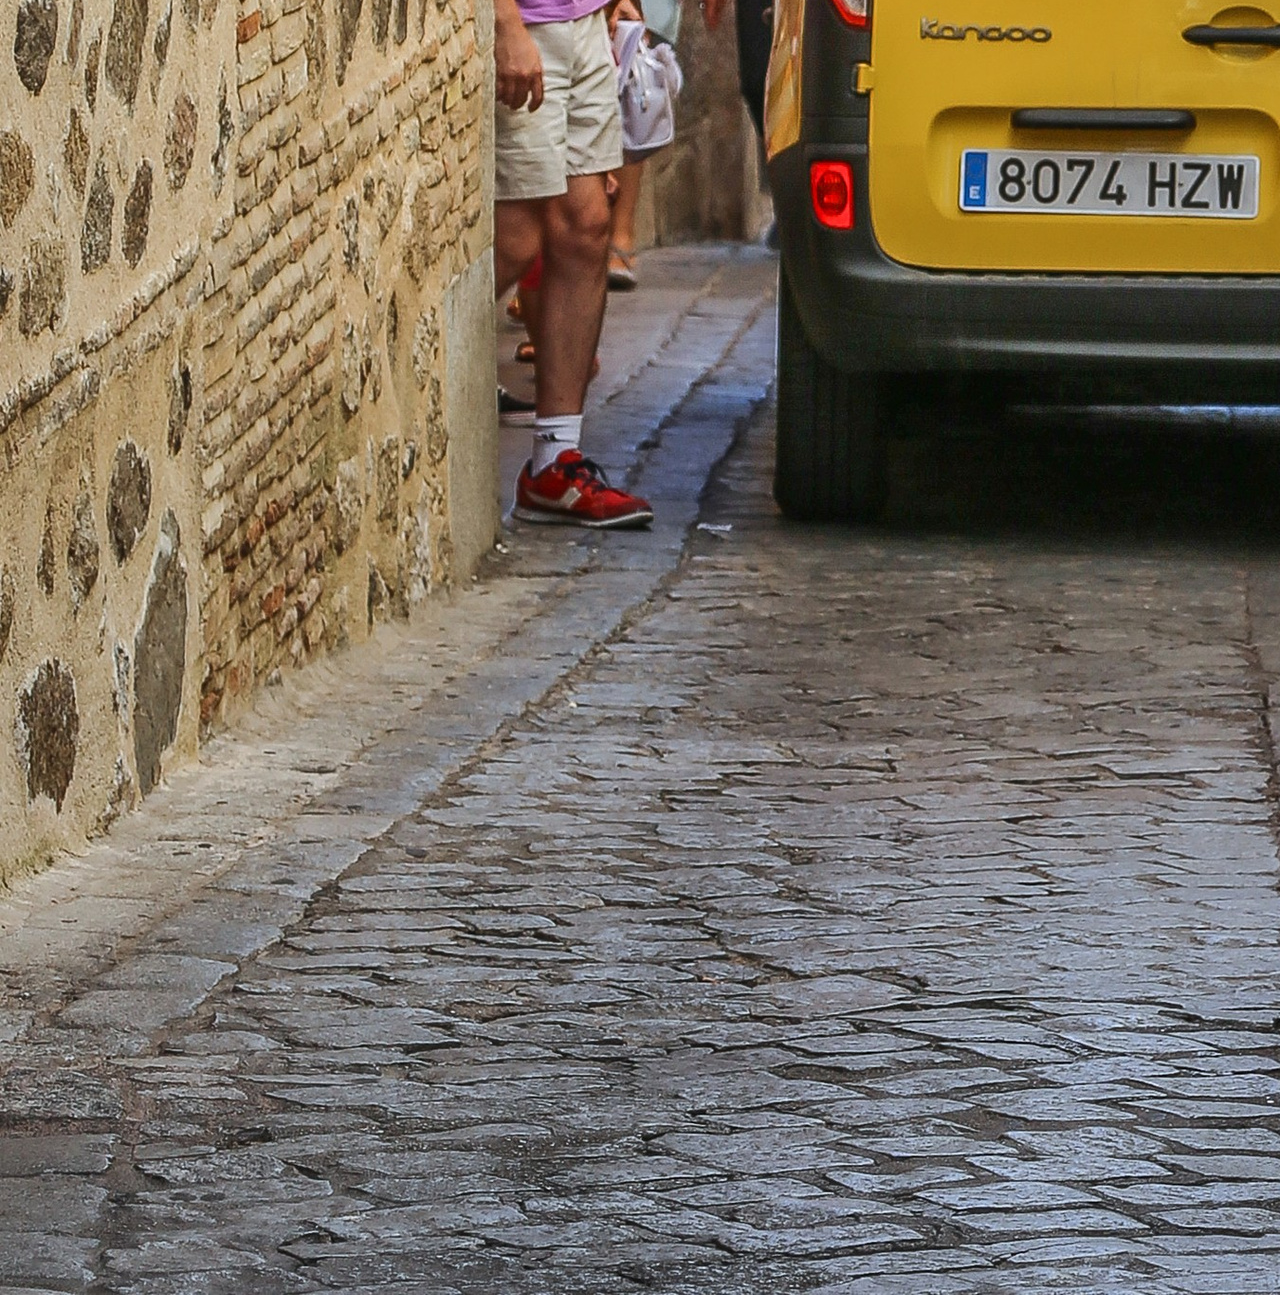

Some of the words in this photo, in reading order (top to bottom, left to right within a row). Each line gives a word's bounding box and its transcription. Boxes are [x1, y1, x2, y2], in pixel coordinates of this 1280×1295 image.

[969, 185, 981, 199] E
[998, 158, 1127, 205] 8074
[1147, 161, 1245, 210] HZW
